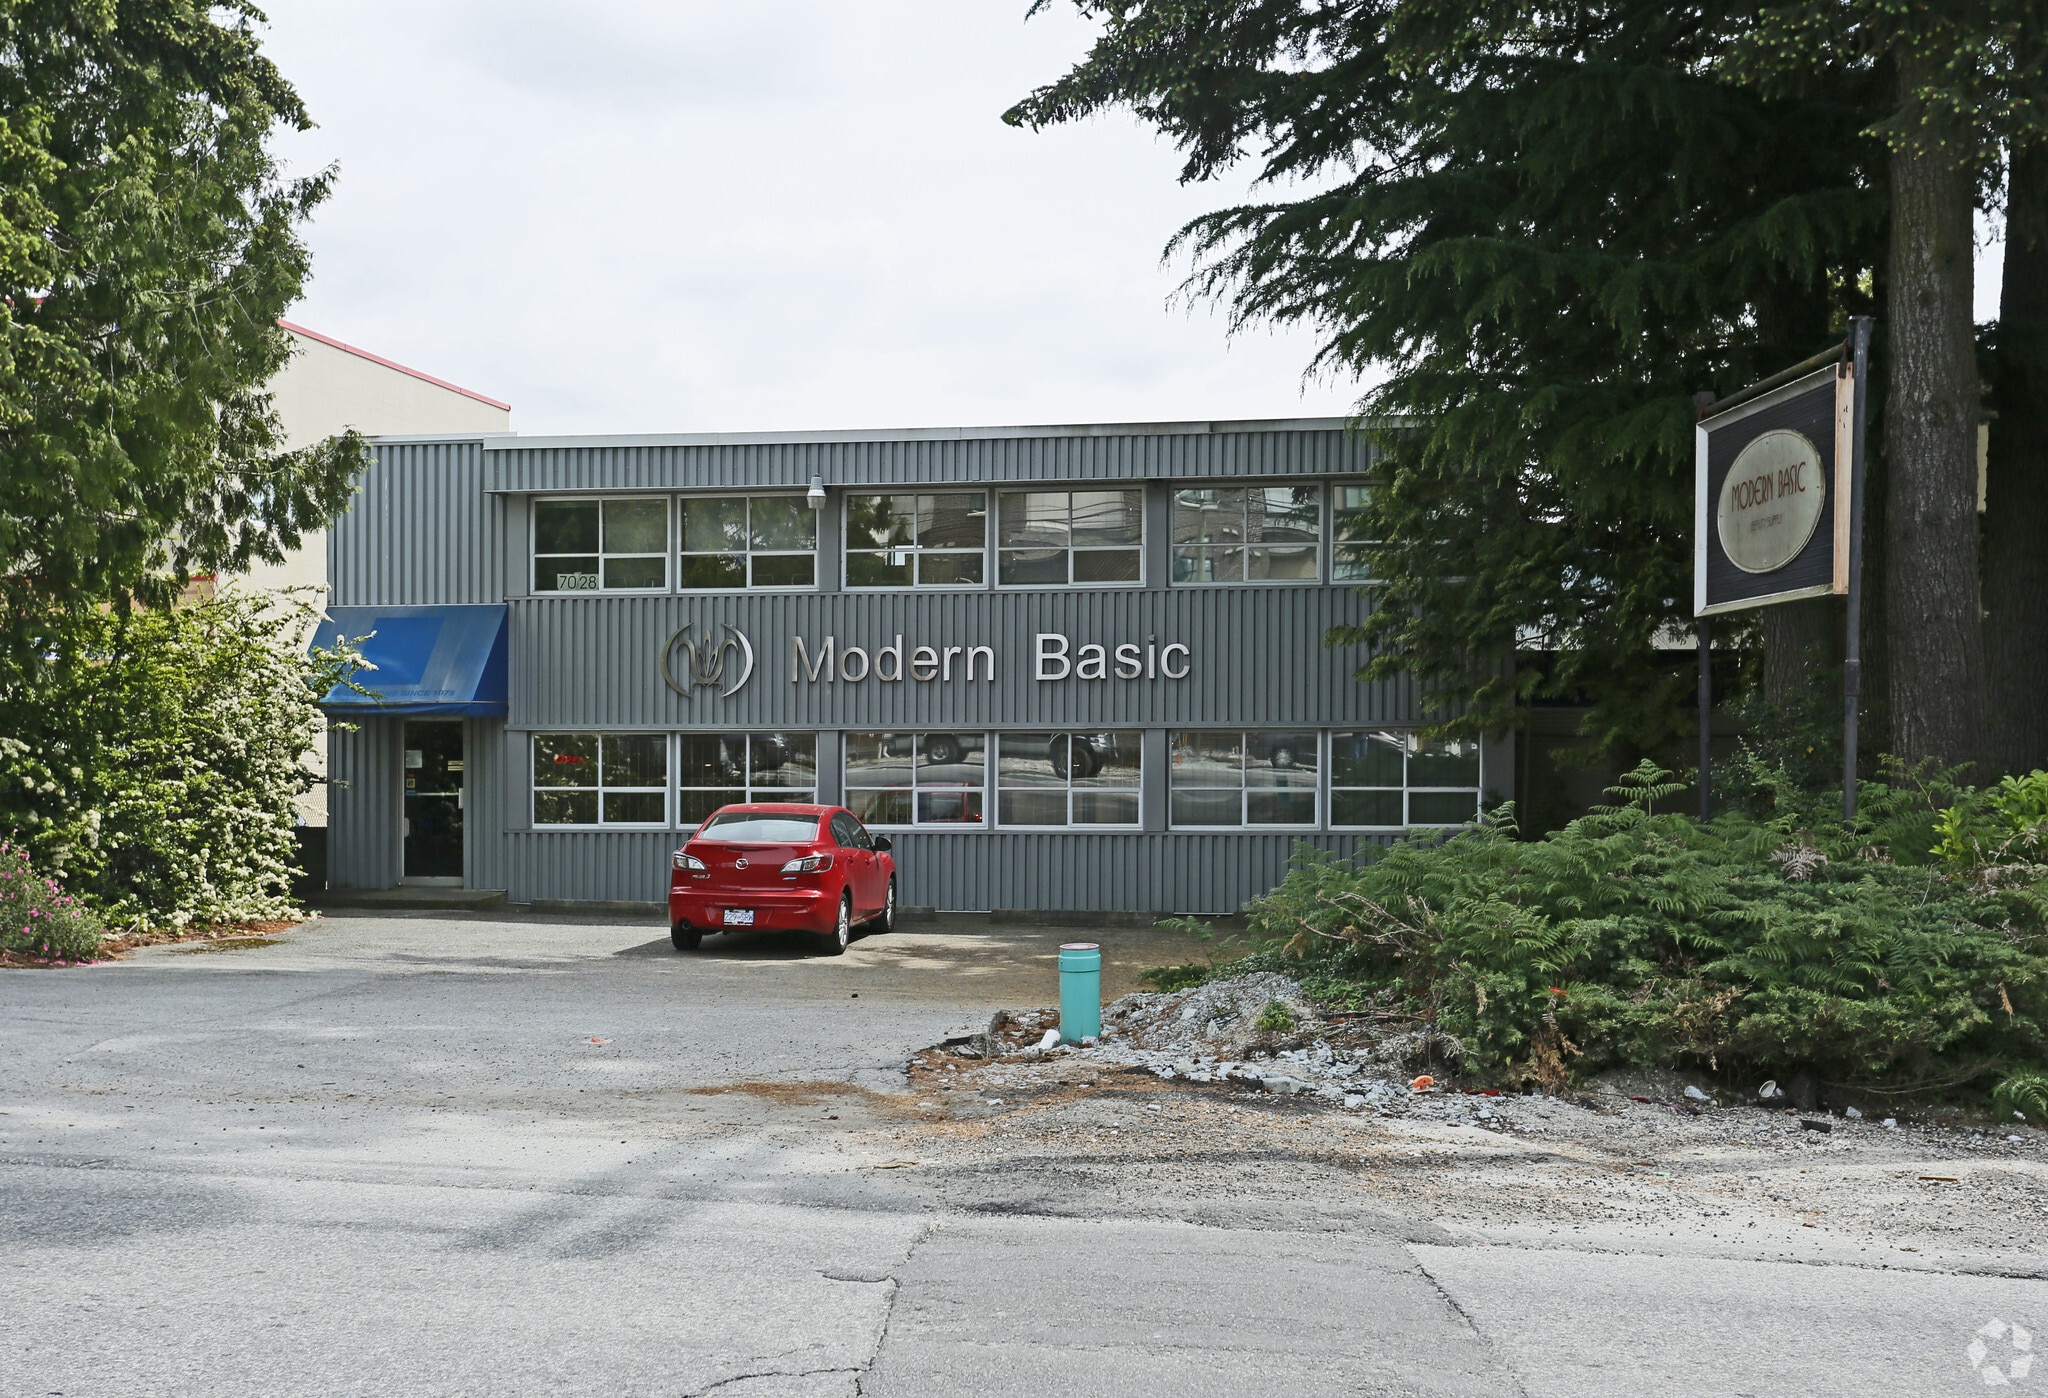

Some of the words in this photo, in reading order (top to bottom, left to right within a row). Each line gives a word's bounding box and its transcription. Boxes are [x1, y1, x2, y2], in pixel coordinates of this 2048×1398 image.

[1732, 472, 1774, 512] MODERN
[1778, 461, 1806, 498] BASIC
[559, 575, 597, 590] 7028
[791, 634, 996, 683] Modern
[1035, 633, 1191, 681] Basic
[400, 689, 431, 697] SINCE
